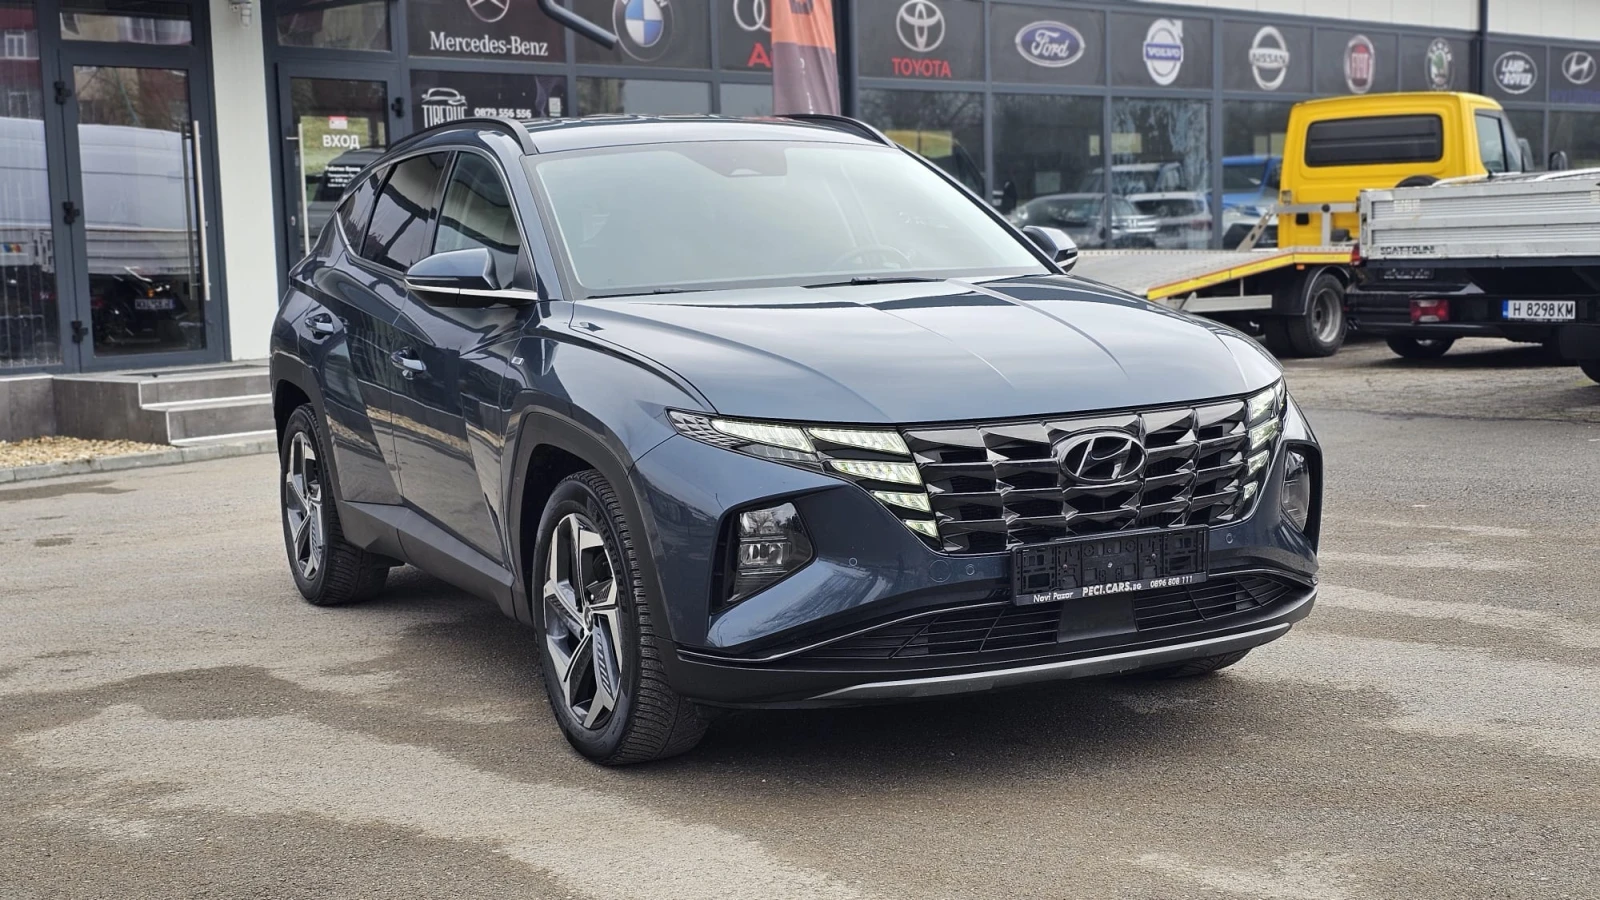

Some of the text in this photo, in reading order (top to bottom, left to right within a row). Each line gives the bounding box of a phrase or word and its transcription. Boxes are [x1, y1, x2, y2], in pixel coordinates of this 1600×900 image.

[429, 30, 549, 56] Mercedes-Benz
[1031, 28, 1070, 58] Ford
[1147, 46, 1181, 58] VOLVO
[1252, 52, 1286, 64] NISSAN
[891, 57, 952, 78] TOYOTA
[474, 107, 532, 119] 0879 556 556
[322, 134, 361, 150] ВХОД
[1513, 302, 1574, 317] H 8298 KM
[1033, 593, 1052, 604] Novi
[1052, 592, 1075, 601] Pazar
[1150, 579, 1167, 589] 0896
[1181, 575, 1193, 584] 111
